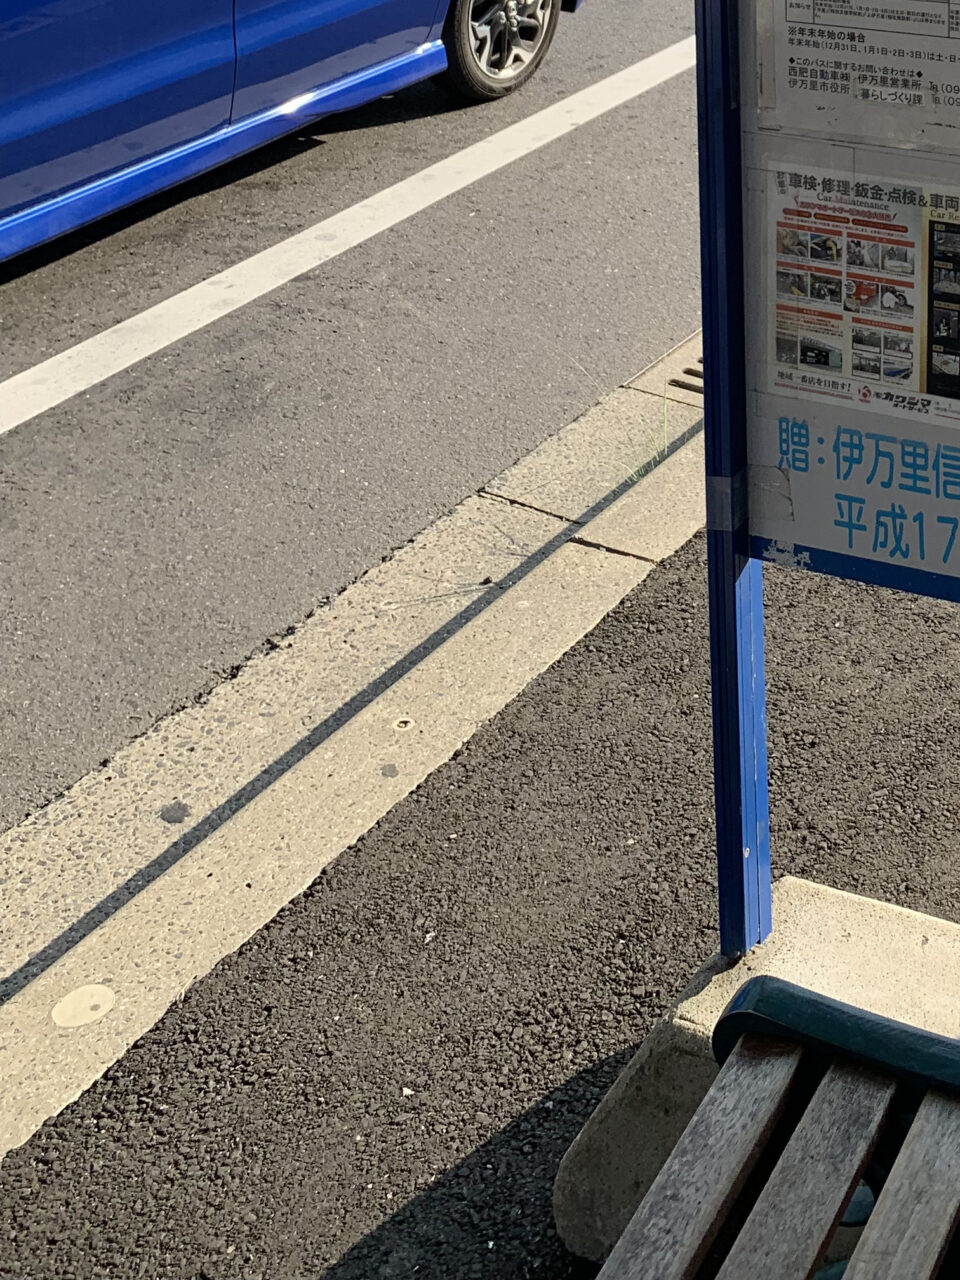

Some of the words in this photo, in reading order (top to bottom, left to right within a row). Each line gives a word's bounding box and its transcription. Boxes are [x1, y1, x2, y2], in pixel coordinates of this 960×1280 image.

[788, 26, 866, 43] ※年末年始の場合
[788, 79, 850, 95] 伊万里市役所
[858, 74, 921, 90] 伊万里営業所
[817, 191, 833, 202] Car
[835, 195, 889, 211] Maintenance
[930, 209, 946, 219] Car
